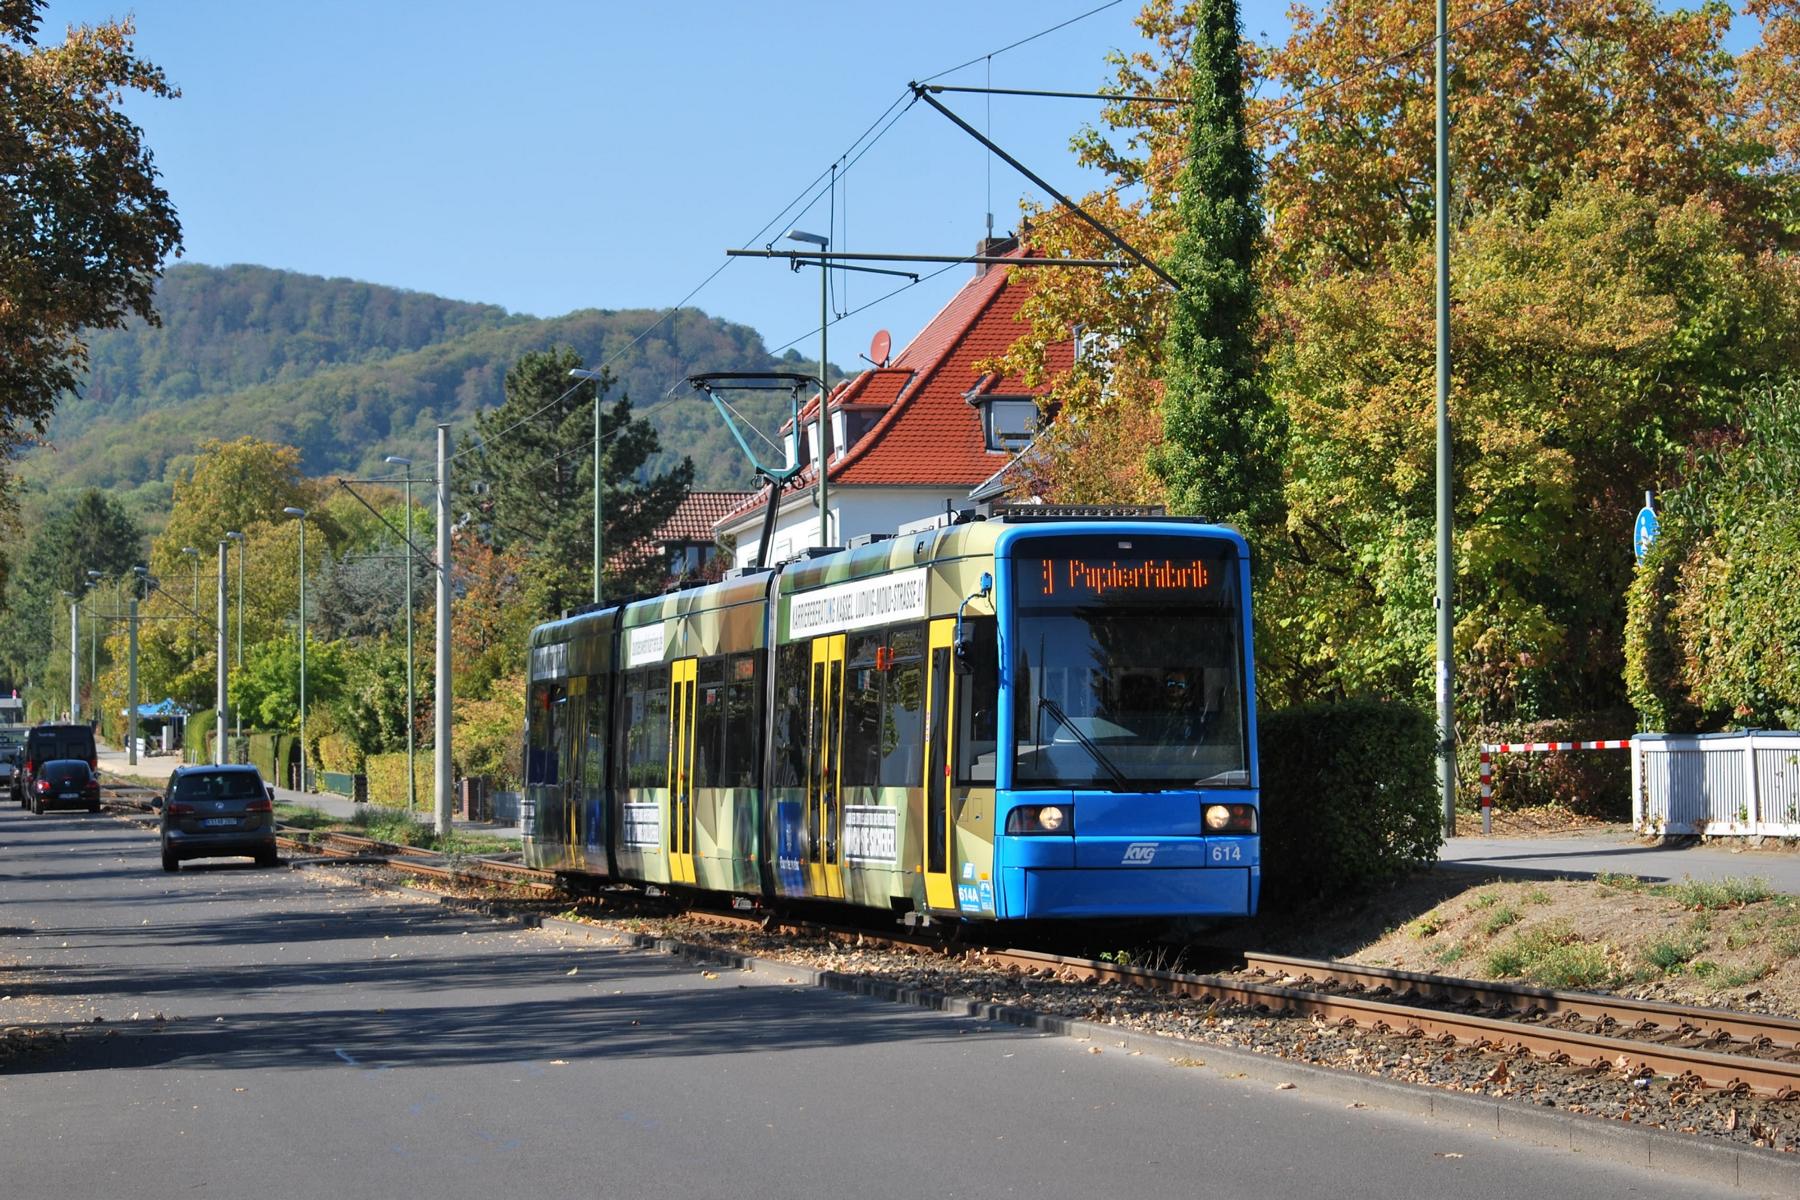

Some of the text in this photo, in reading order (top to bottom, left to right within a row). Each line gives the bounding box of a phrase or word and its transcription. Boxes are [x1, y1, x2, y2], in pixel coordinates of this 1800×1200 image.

[1069, 559, 1208, 594] Papierfabrik
[836, 593, 854, 623] KASSEL
[1122, 845, 1157, 862] KVG
[1212, 846, 1241, 861] 614
[959, 887, 979, 903] 614A
